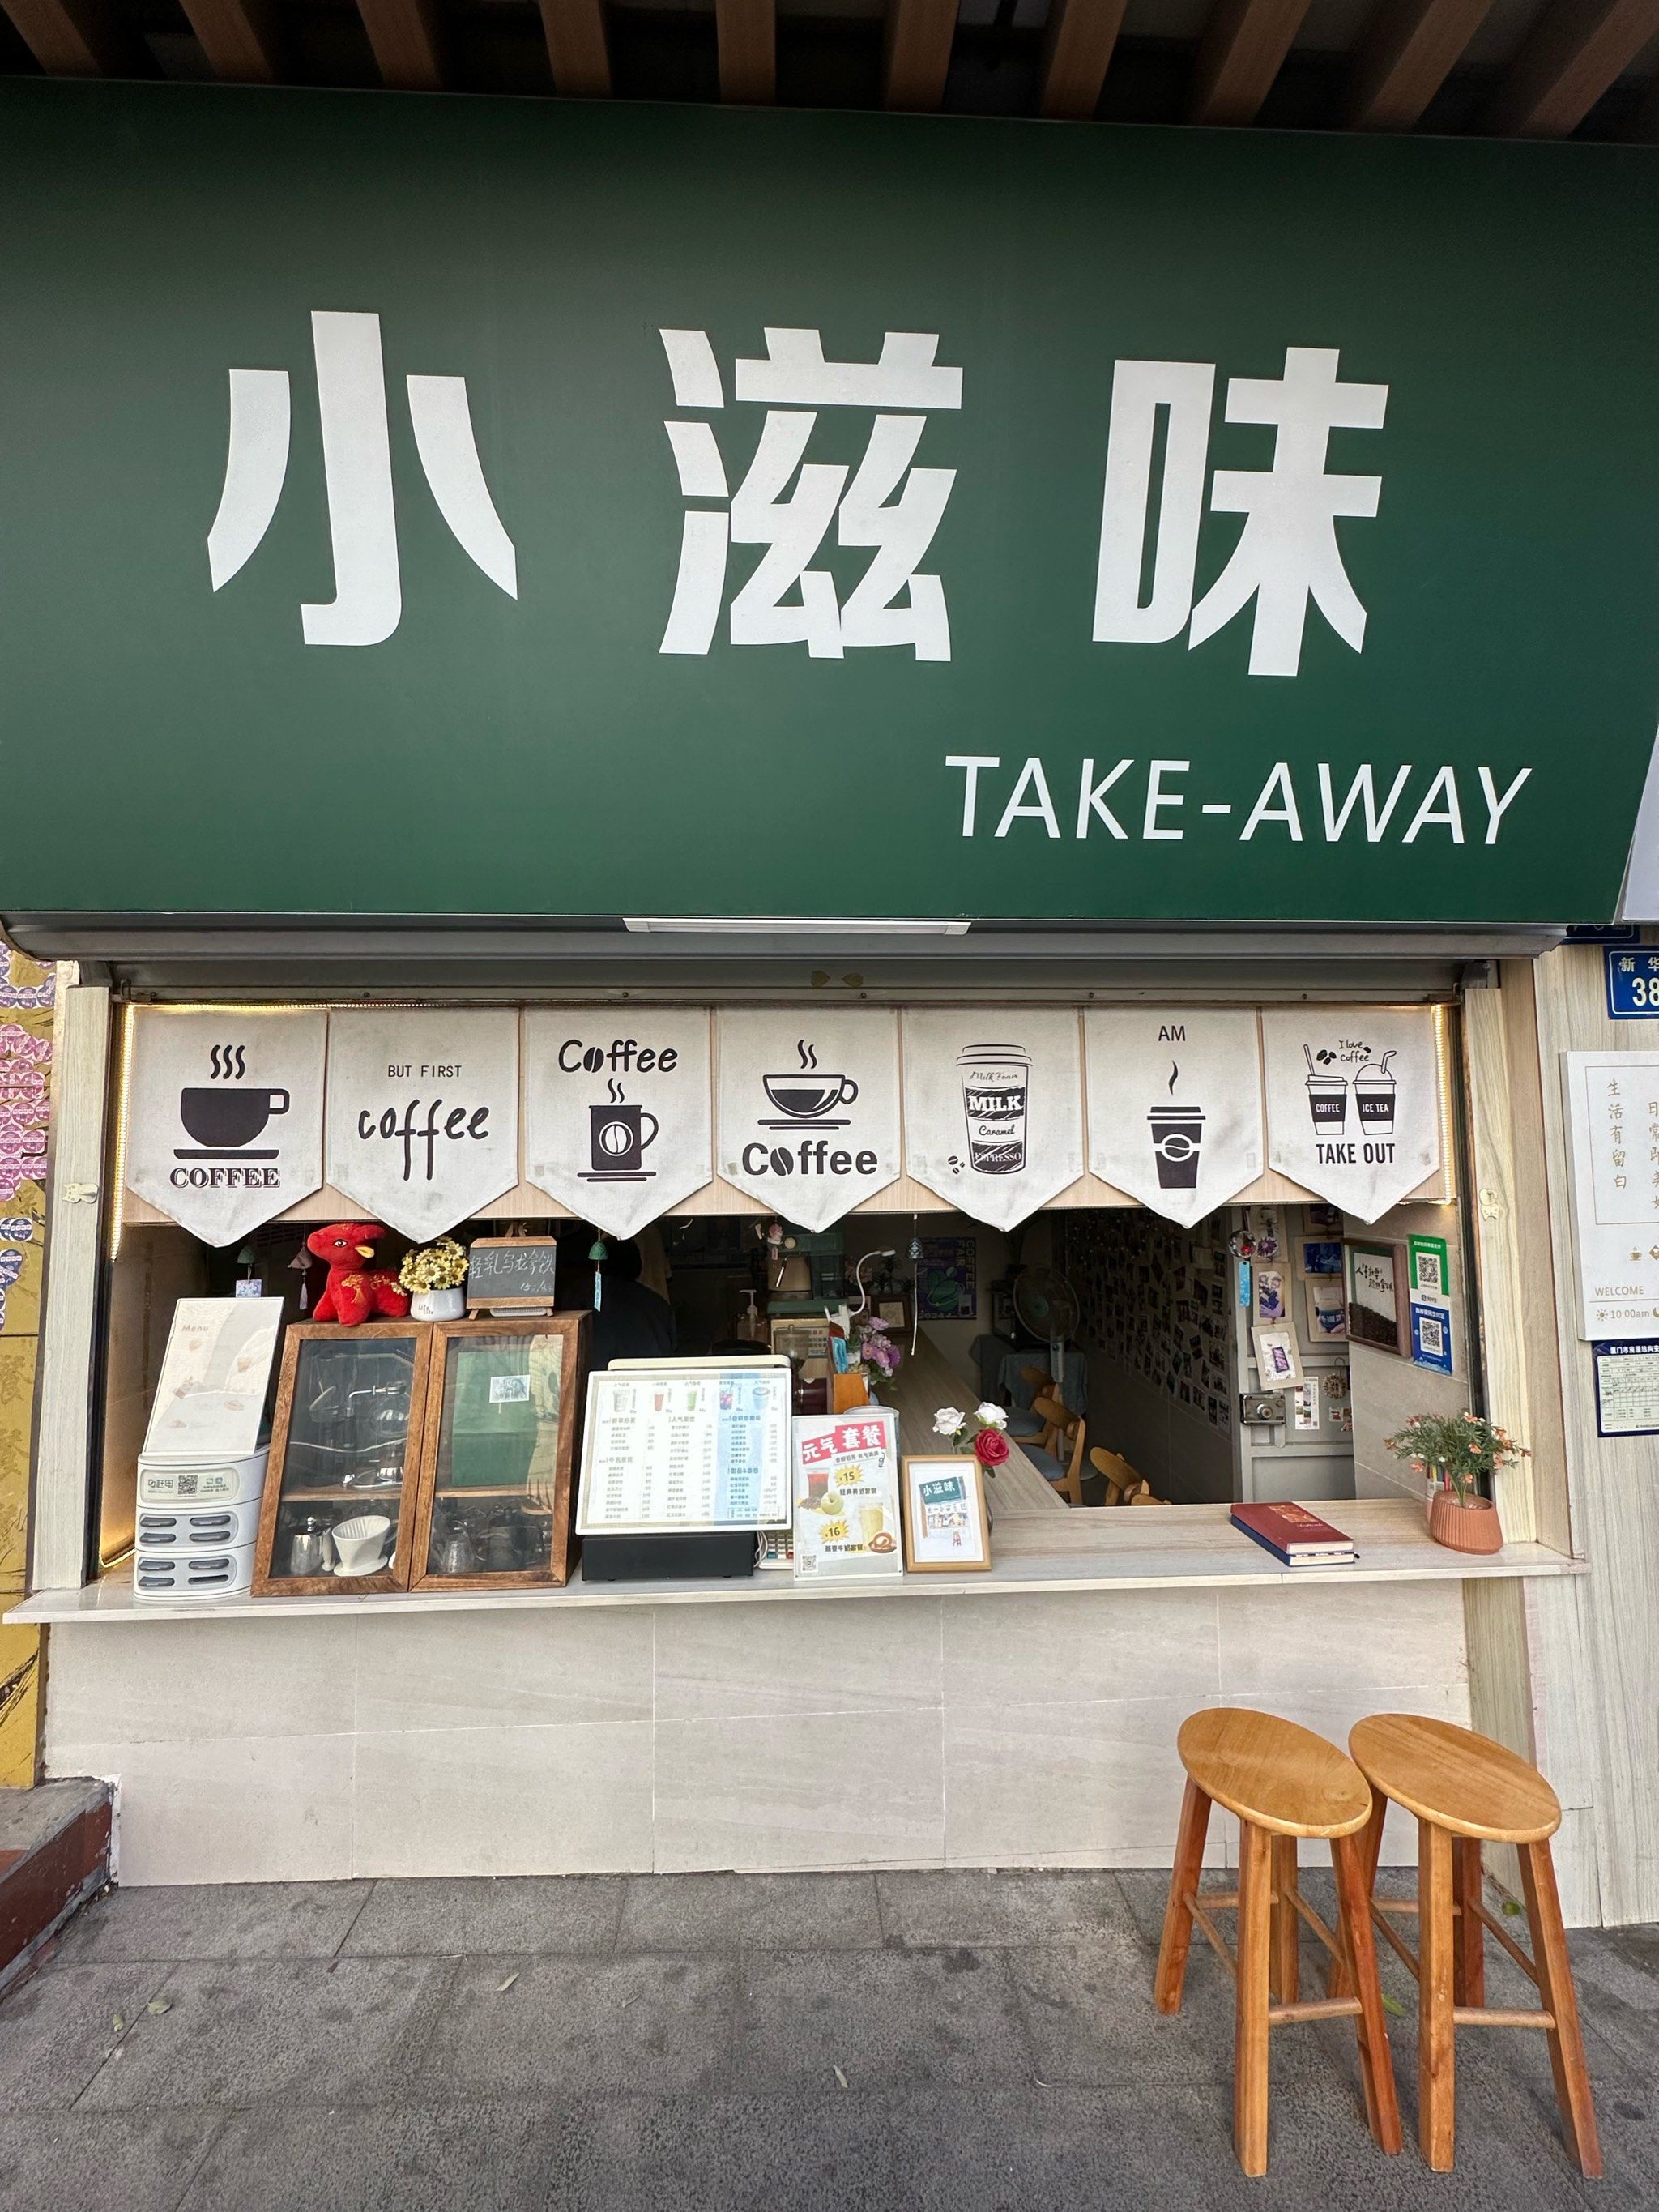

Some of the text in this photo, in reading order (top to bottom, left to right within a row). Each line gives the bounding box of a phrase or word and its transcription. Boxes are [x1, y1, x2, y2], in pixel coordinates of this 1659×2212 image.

[207, 310, 1390, 677] 小滋味
[945, 755, 1533, 848] TAKE-AWAY
[1632, 977, 1659, 1006] 38
[1159, 1026, 1186, 1042] AM
[1339, 1040, 1363, 1049] I love
[559, 1040, 678, 1074] Coffee
[1341, 1051, 1369, 1063] coffee
[388, 1065, 461, 1078] BUT FIRST
[970, 1071, 994, 1082] Milk
[967, 1095, 1023, 1112] MILK
[1316, 1104, 1340, 1112] COFFEE
[1362, 1104, 1389, 1112] ICE TEA
[979, 1125, 1015, 1136] Caramel
[1607, 1078, 1627, 1189] 生活有留白
[359, 1099, 490, 1181] coffee
[743, 1139, 878, 1177] Coffee
[974, 1152, 1021, 1162] ESPRESSO
[1316, 1143, 1395, 1164] TAKE OUT
[170, 1168, 280, 1189] COFFEE
[1595, 1286, 1644, 1296] WELCOME
[181, 1324, 208, 1332] Menu
[803, 1424, 881, 1462] 元气套餐
[923, 1481, 955, 1496] 小滋味
